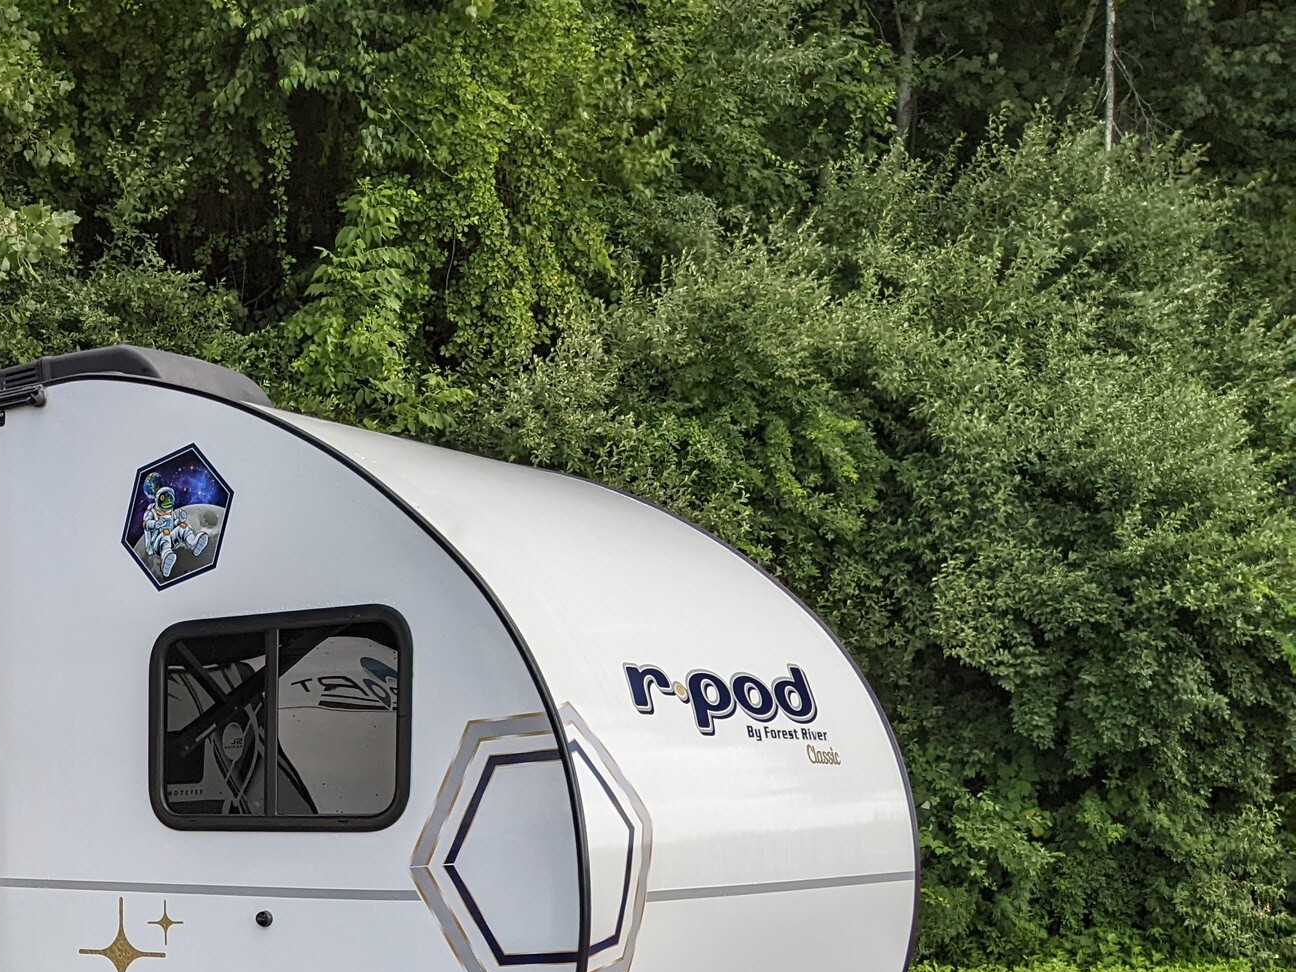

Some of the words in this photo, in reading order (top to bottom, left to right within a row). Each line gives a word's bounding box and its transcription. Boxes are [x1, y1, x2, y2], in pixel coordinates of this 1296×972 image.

[746, 725, 762, 741] By
[764, 726, 800, 740] Forest
[801, 728, 827, 741] River
[806, 743, 842, 765] Classic
